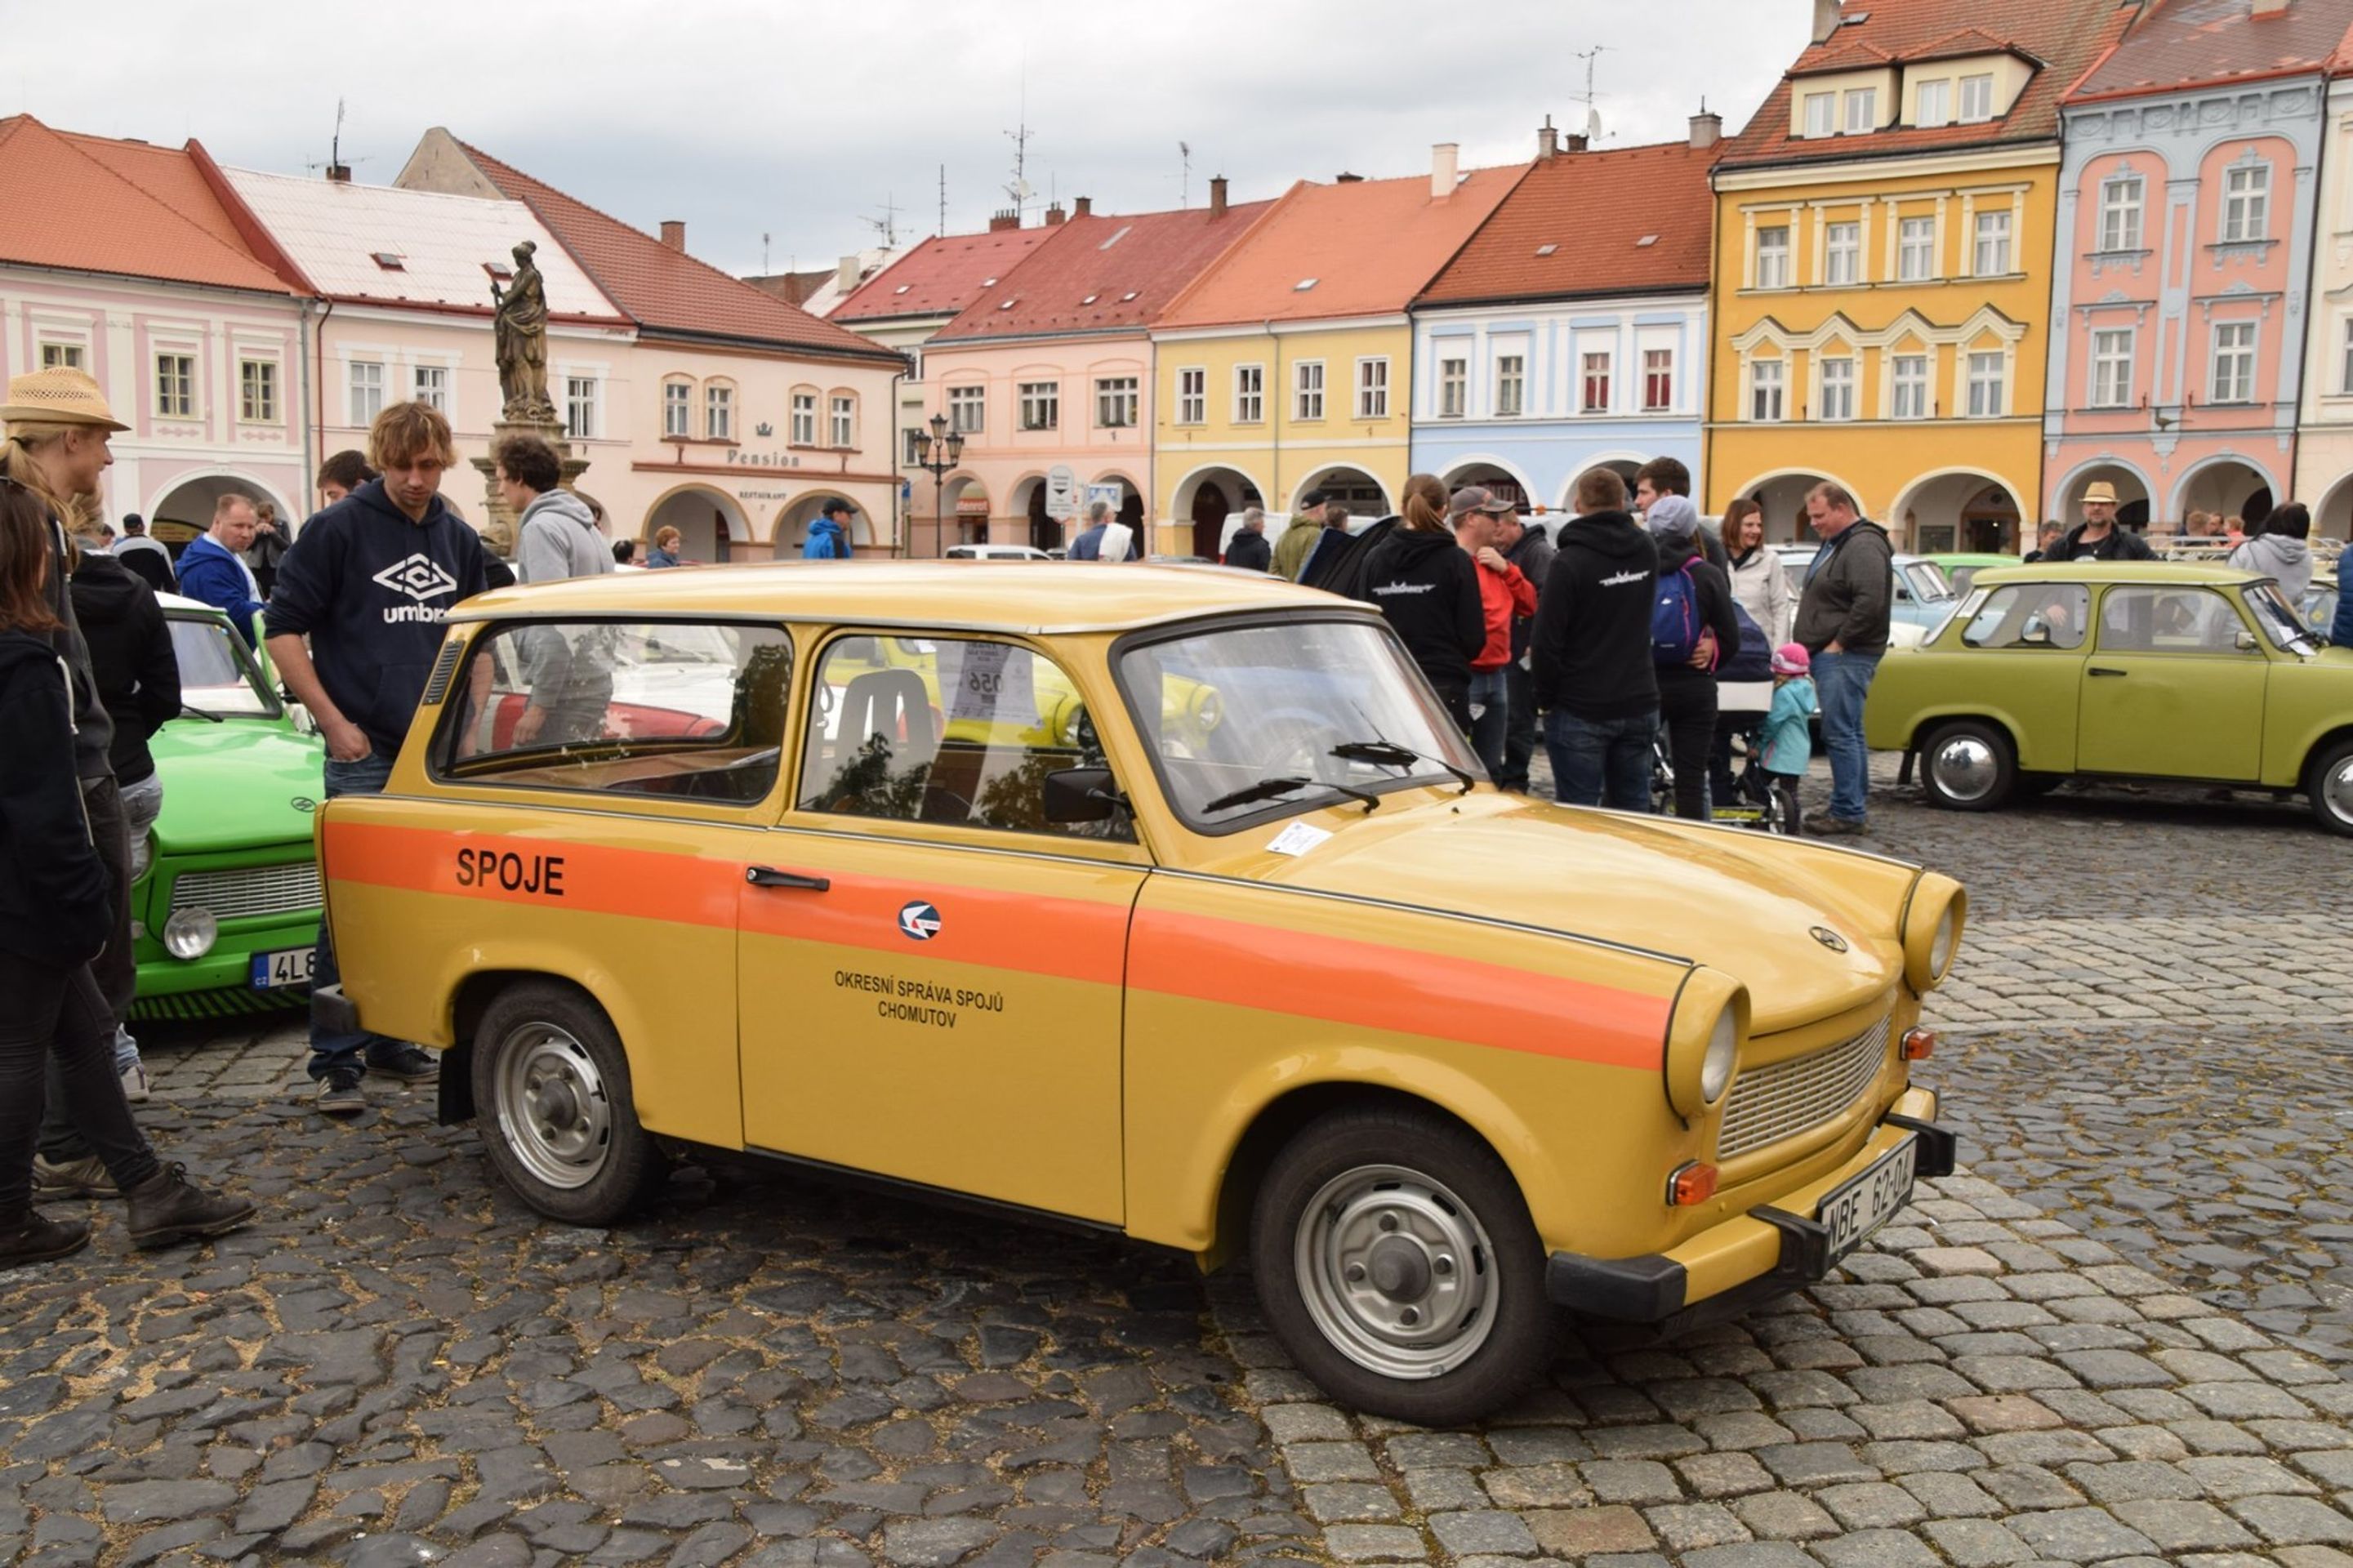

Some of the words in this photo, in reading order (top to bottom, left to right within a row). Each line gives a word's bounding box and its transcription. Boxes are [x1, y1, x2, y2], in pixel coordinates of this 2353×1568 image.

[727, 449, 800, 467] Pension
[383, 602, 446, 623] umbr
[456, 848, 564, 896] SPOJE
[834, 969, 894, 995] OKRESNÍ
[898, 980, 952, 1004] SPRÁVA
[878, 1000, 957, 1028] CHOMUTOV
[1829, 1189, 1862, 1248] NBE
